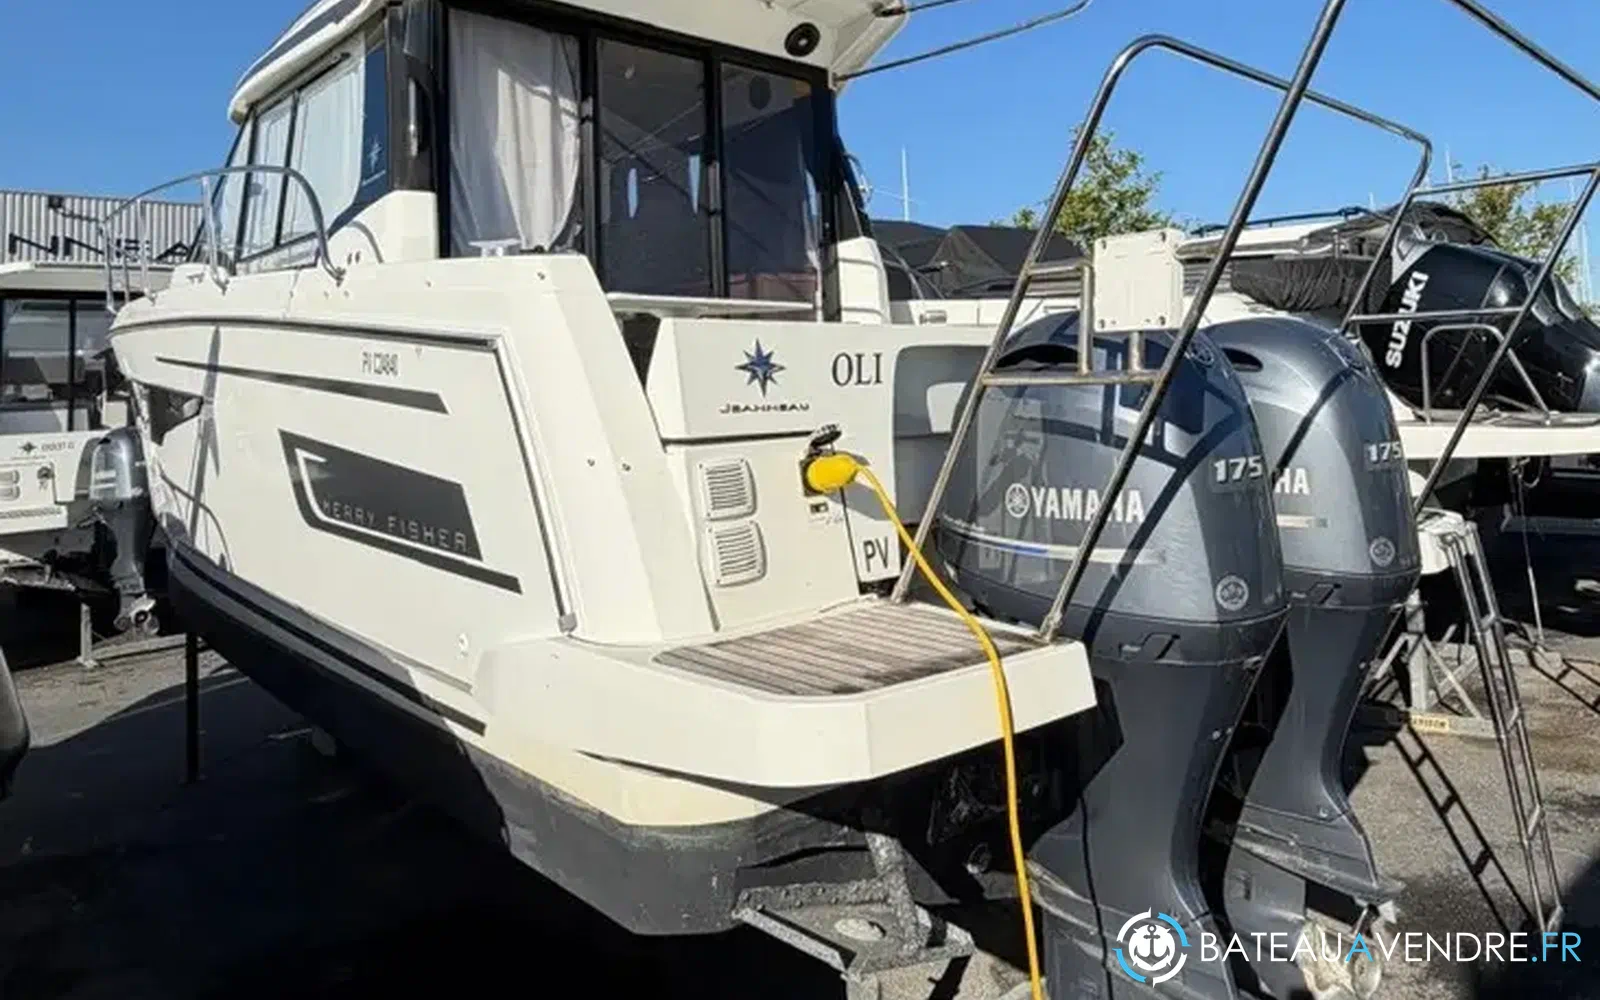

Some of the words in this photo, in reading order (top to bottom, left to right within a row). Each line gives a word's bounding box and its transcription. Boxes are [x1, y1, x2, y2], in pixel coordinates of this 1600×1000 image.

[1385, 270, 1430, 369] SUZUKI
[831, 352, 883, 387] OLI
[1213, 455, 1264, 483] 175
[1367, 441, 1402, 463] 175
[386, 515, 469, 552] FISHER
[862, 536, 890, 573] PV
